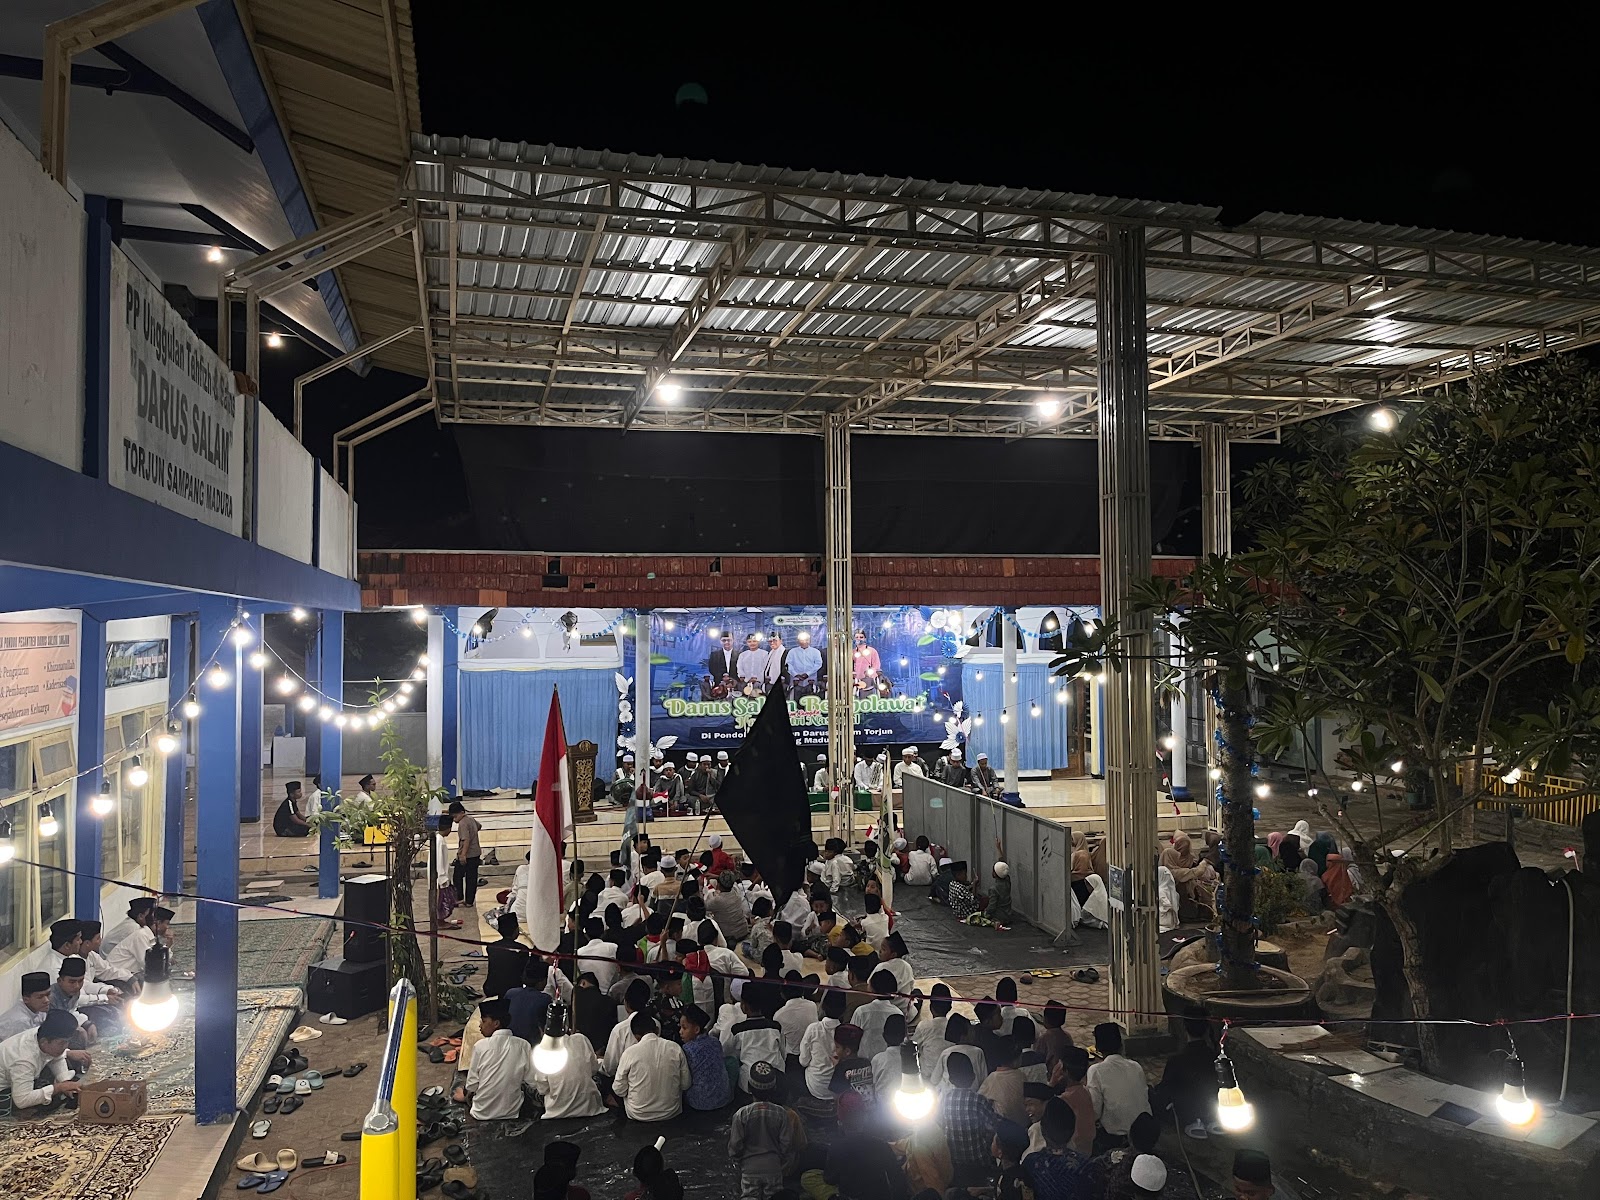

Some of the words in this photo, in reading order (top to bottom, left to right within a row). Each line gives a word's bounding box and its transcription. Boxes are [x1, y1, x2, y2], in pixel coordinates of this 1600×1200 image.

[126, 282, 140, 330] PP
[143, 298, 185, 371] Unggulan
[123, 437, 164, 488] TORJUN
[167, 461, 205, 507] SAMPANG
[206, 483, 233, 519] MADURA
[3, 665, 29, 680] Pengajaran
[5, 684, 39, 698] Pembangunan
[30, 703, 50, 716] Keluarga
[664, 698, 731, 717] Darus
[864, 728, 893, 736] Torjun
